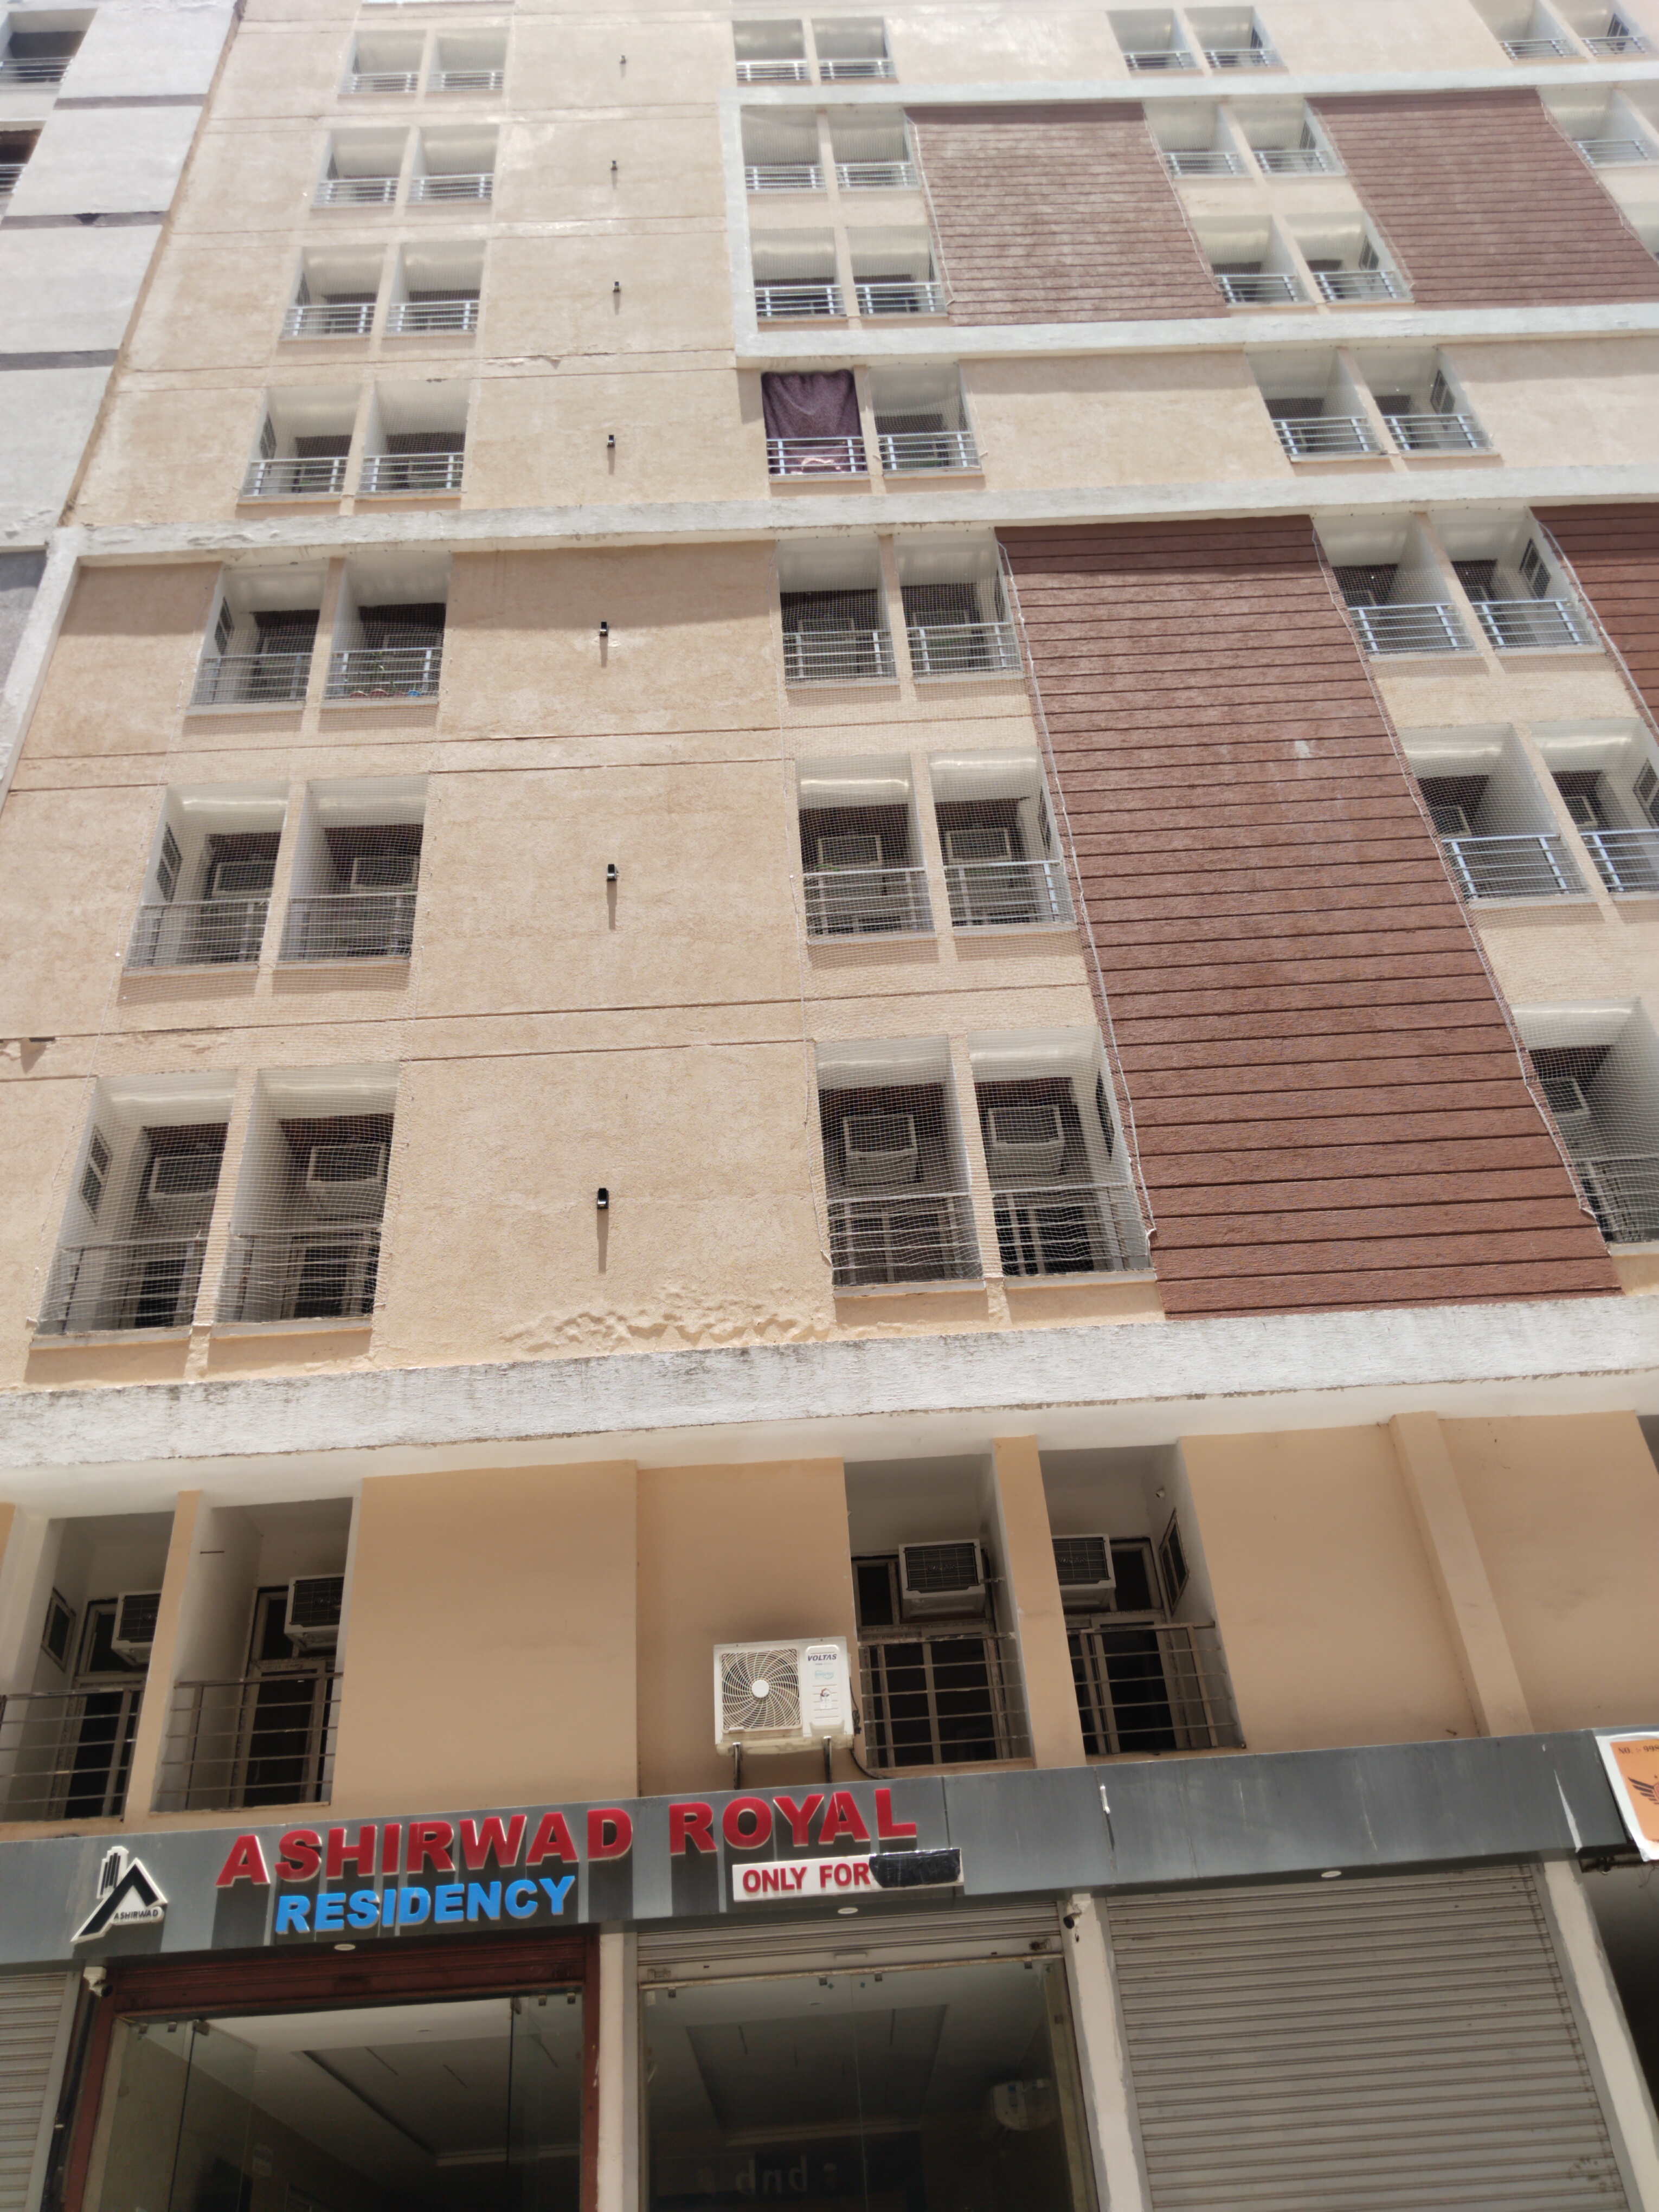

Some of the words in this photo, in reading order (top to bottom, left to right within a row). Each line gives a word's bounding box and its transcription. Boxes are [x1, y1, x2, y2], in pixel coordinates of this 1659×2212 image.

[215, 1808, 633, 1888] ASHIRWAD
[669, 1788, 917, 1855] ROYAL
[742, 1866, 807, 1893] ONLY
[819, 1862, 871, 1888] FOR
[114, 1909, 158, 1919] ASHIRWAD
[275, 1875, 575, 1934] RESIDENCY
